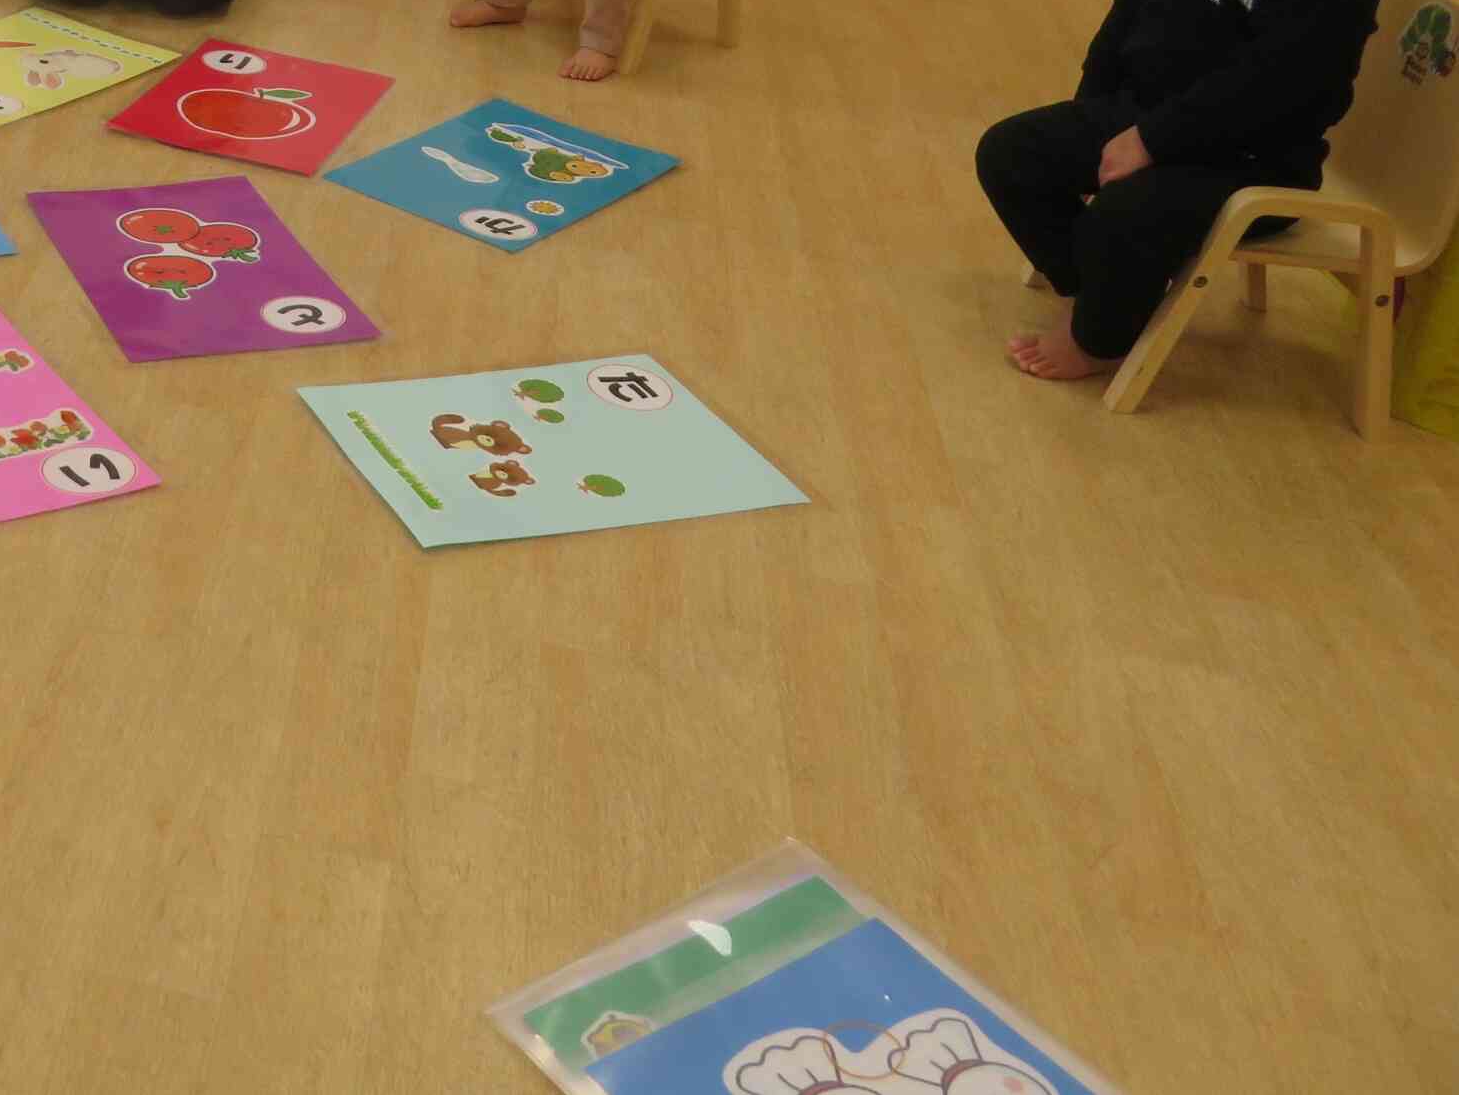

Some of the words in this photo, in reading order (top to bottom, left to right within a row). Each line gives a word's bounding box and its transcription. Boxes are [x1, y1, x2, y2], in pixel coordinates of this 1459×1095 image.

[475, 216, 525, 235] か
[278, 303, 325, 326] と
[598, 372, 659, 402] た
[60, 453, 121, 487] い
